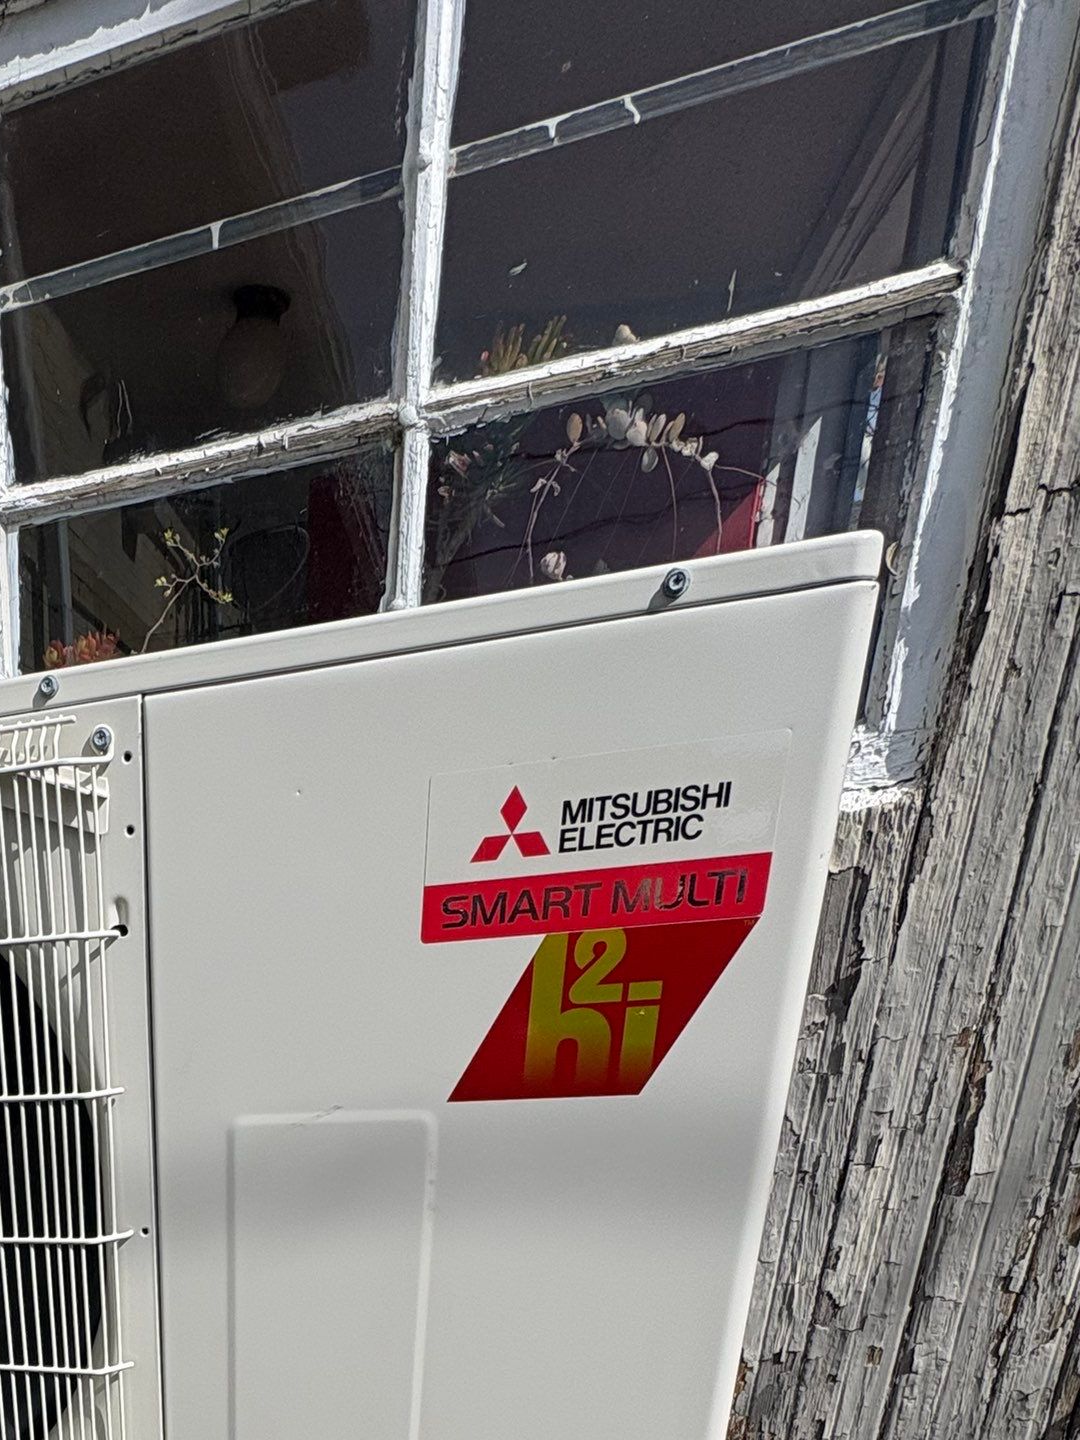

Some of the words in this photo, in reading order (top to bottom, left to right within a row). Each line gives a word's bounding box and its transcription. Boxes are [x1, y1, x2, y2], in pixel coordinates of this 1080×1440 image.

[561, 781, 732, 826] MITSUBISHI
[558, 814, 704, 854] ELECTRIC
[441, 882, 603, 929] SMART
[610, 868, 749, 914] MULTI
